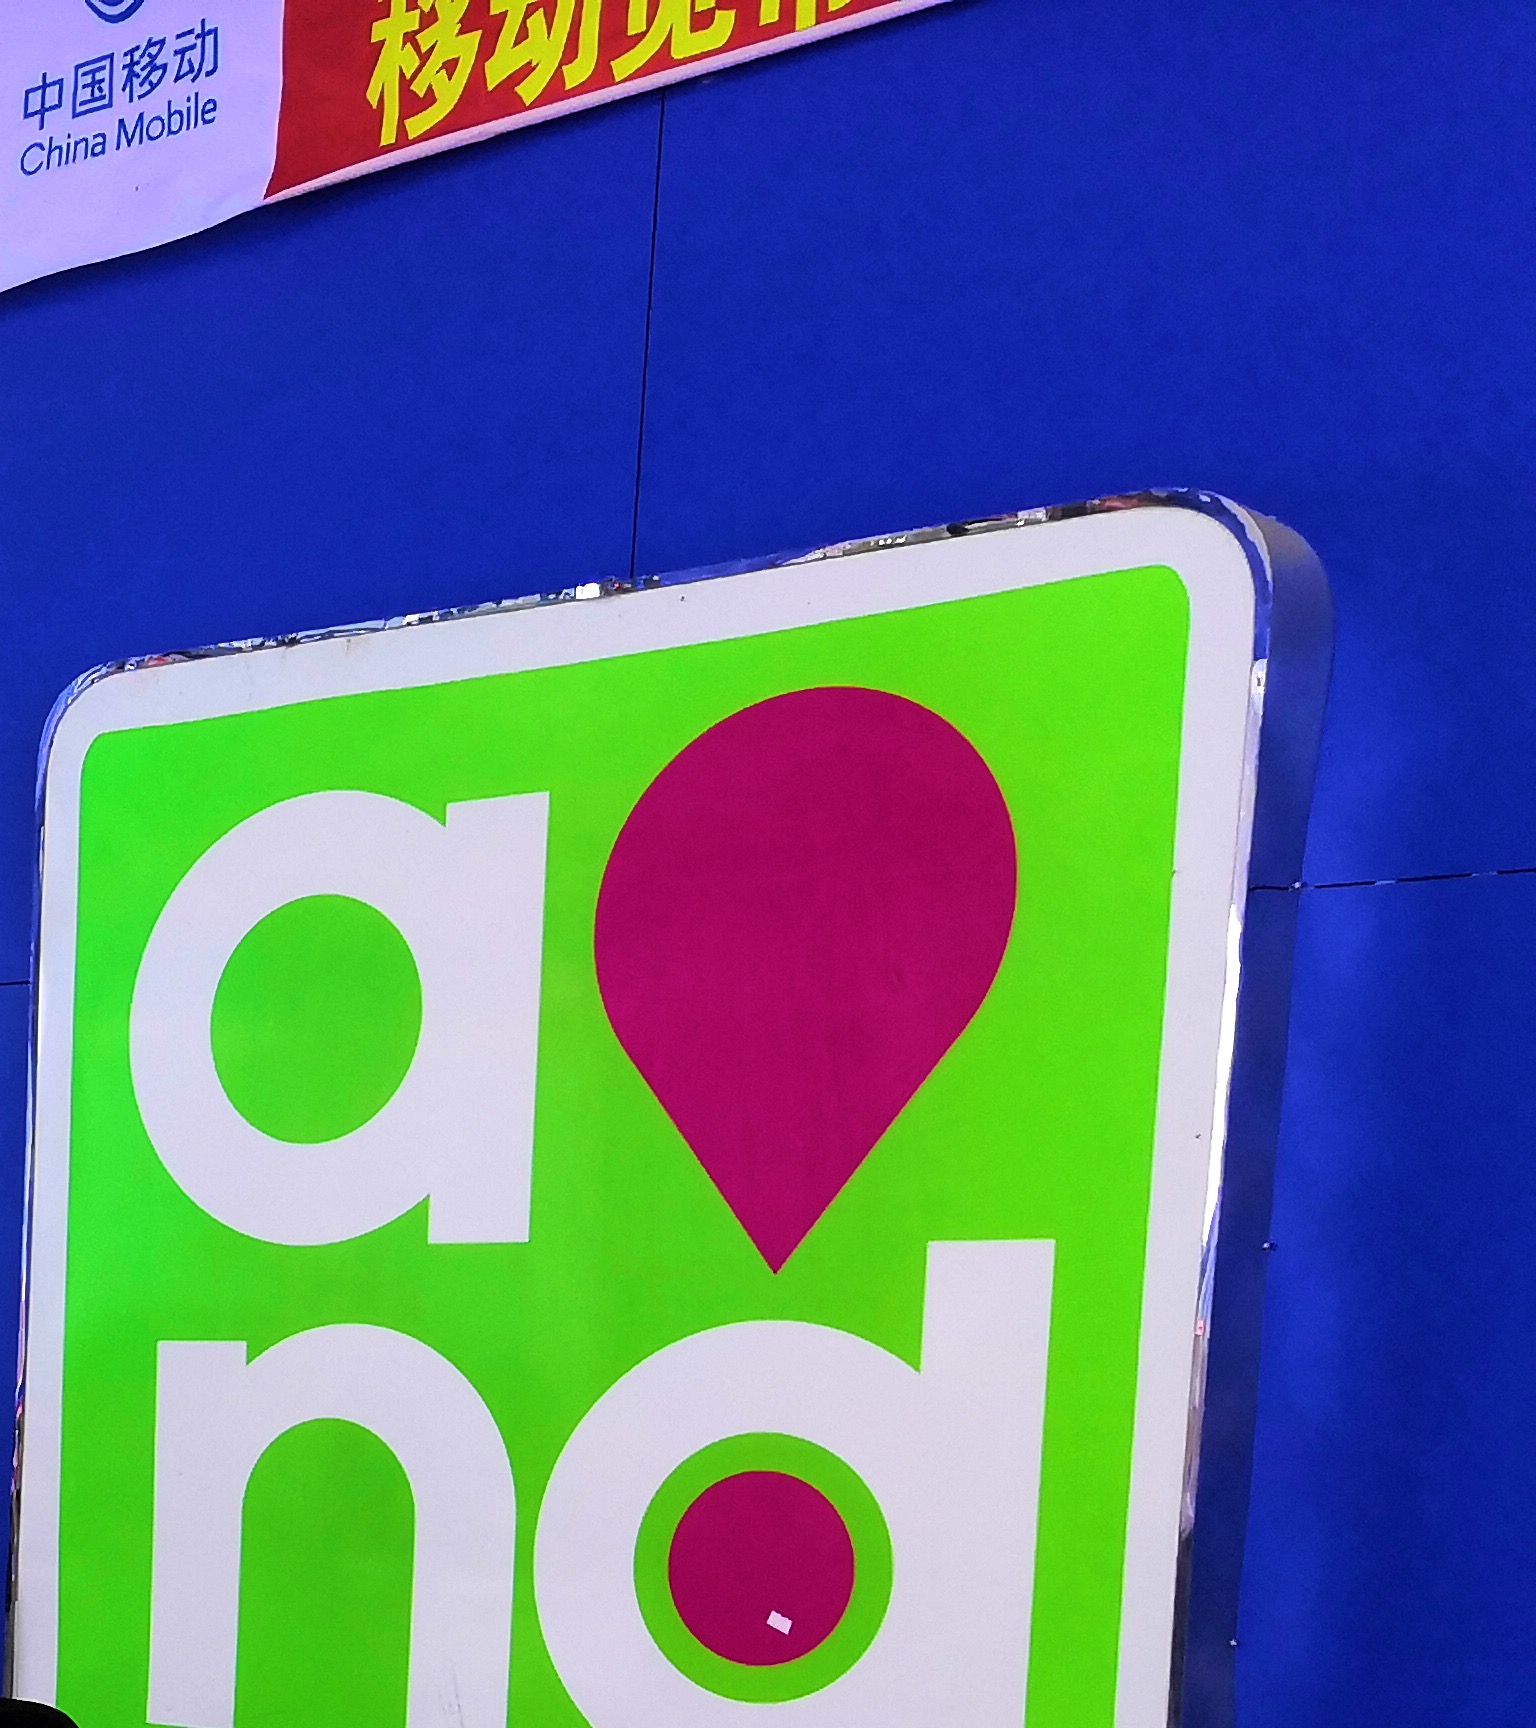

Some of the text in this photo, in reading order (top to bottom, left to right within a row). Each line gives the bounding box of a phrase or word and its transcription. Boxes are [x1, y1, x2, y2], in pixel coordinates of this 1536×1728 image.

[22, 22, 219, 131] 中国移动
[20, 93, 218, 179] China Mobile
